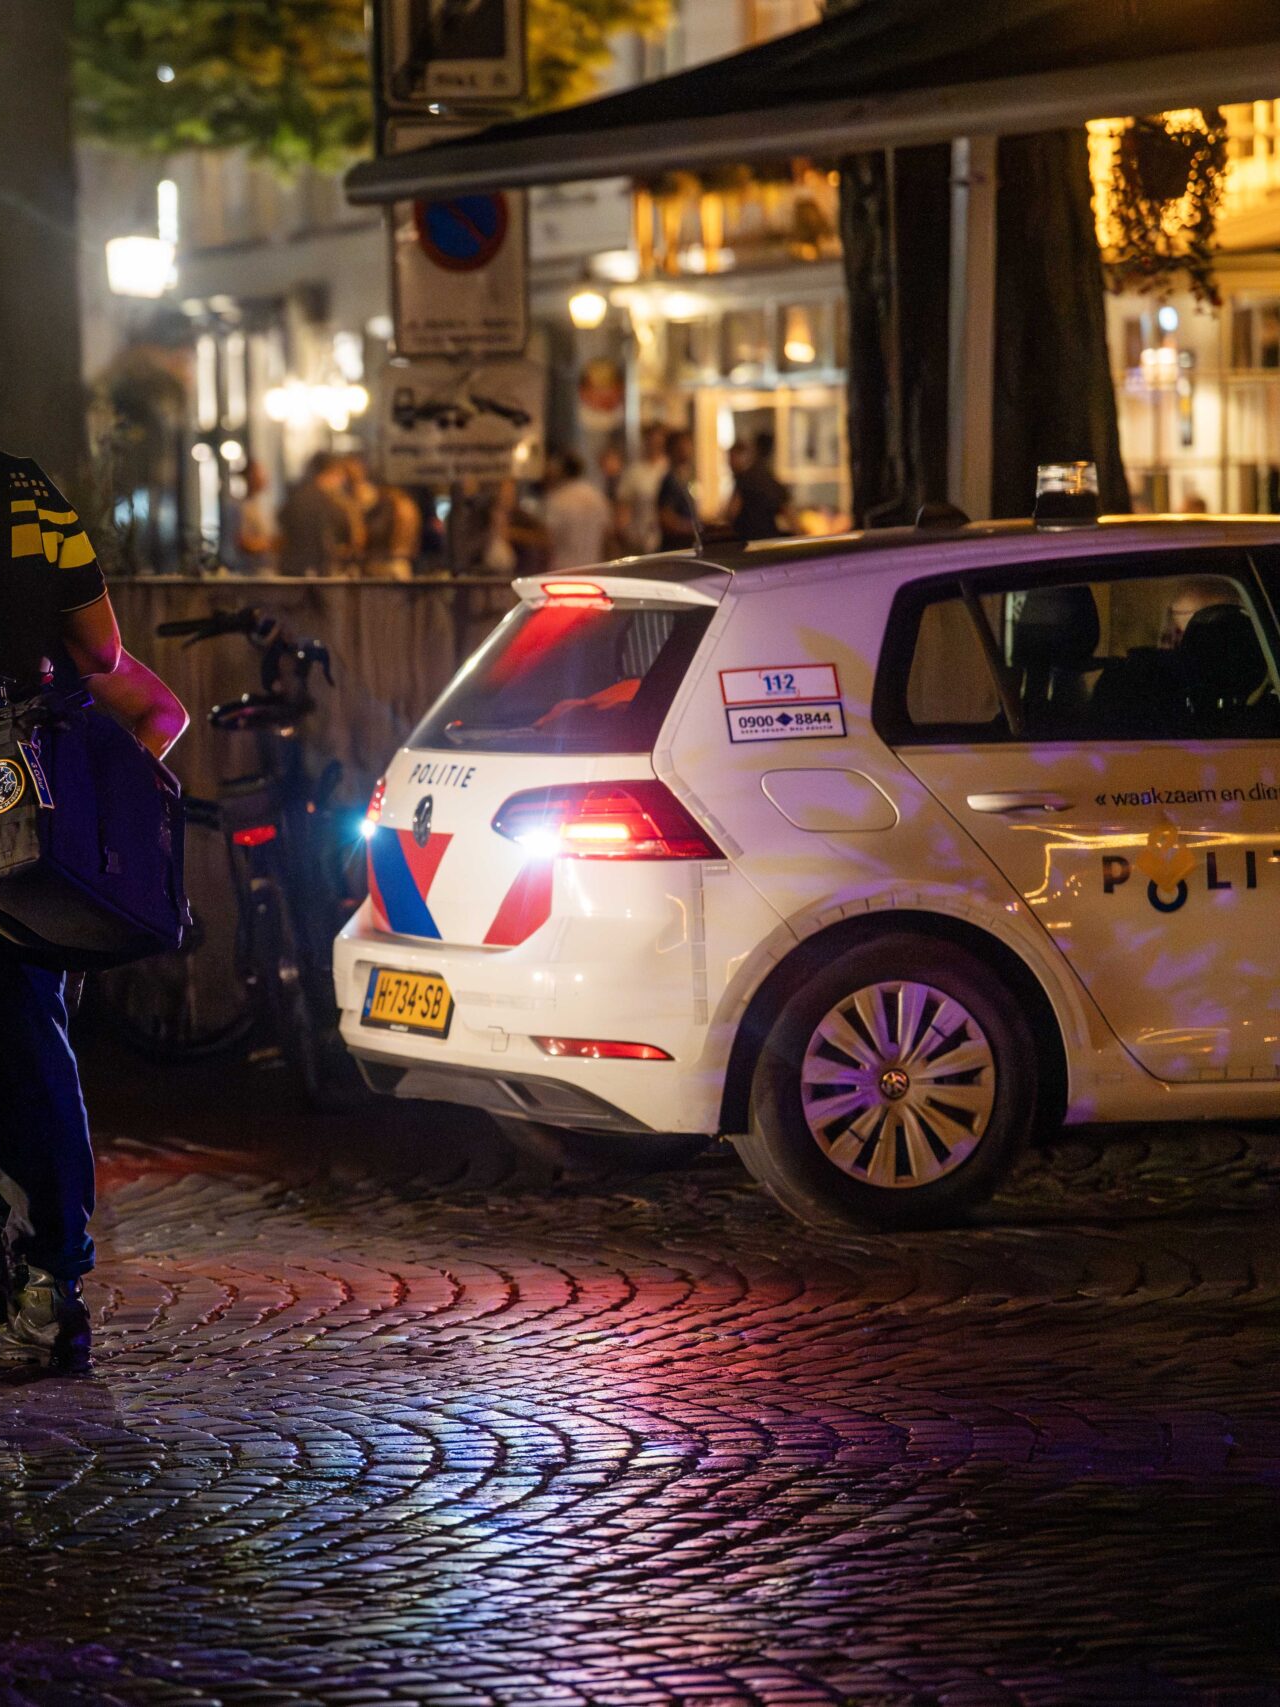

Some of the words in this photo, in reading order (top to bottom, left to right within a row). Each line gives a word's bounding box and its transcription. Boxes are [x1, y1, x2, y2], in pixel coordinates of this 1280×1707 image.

[762, 674, 796, 692] 112
[738, 715, 774, 729] 0900
[794, 712, 831, 725] 8844
[408, 763, 476, 788] POLITIE
[1221, 788, 1245, 801] en
[1249, 782, 1280, 800] die
[1102, 850, 1280, 913] POLI
[375, 976, 444, 1020] H-734-SB
